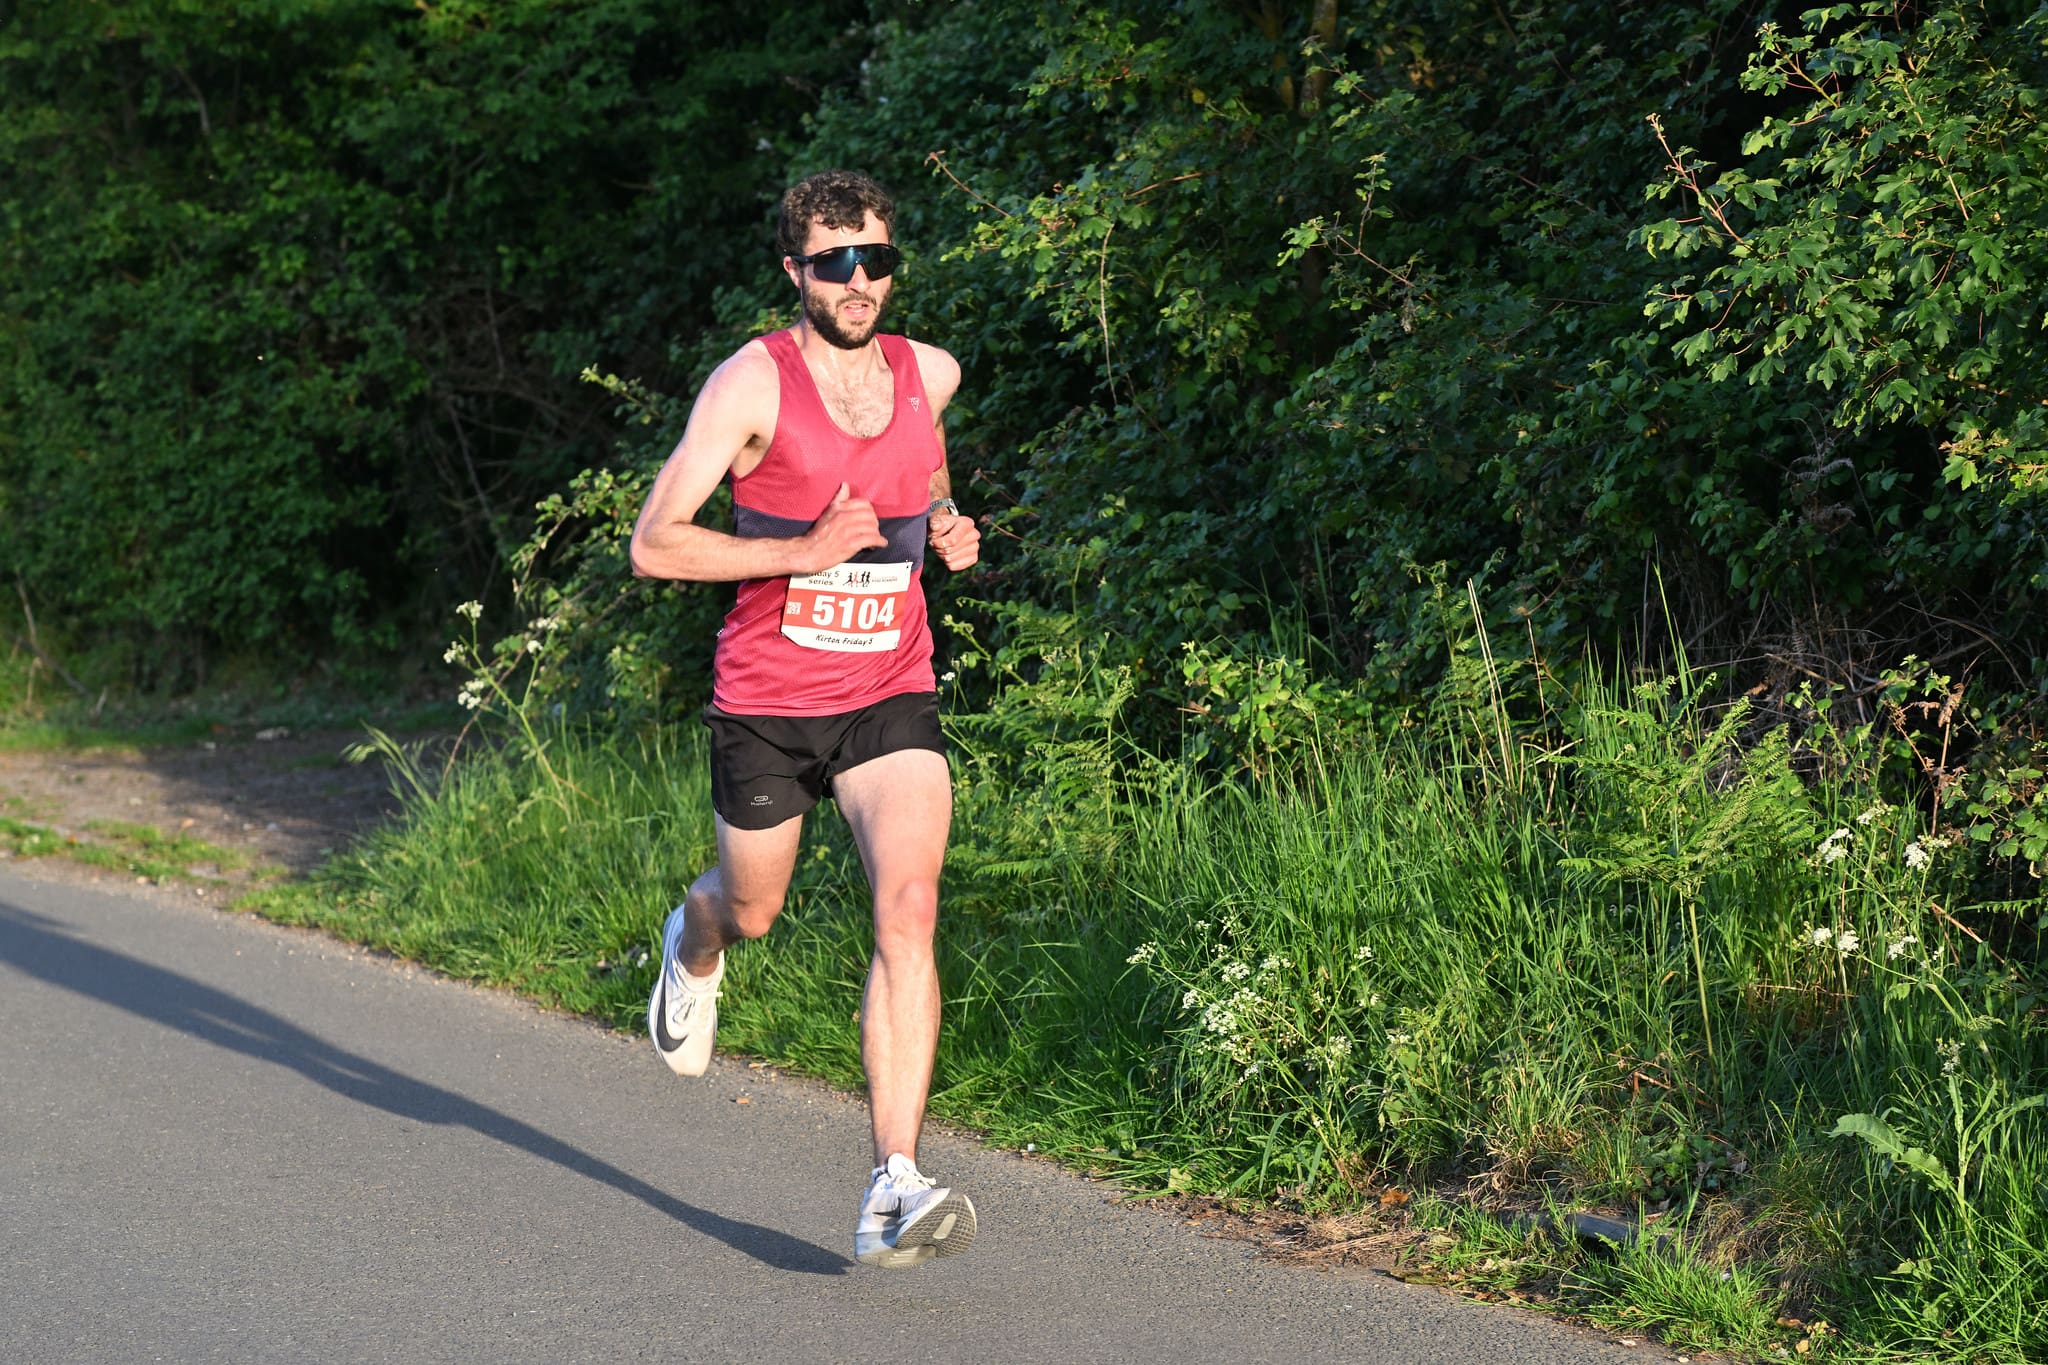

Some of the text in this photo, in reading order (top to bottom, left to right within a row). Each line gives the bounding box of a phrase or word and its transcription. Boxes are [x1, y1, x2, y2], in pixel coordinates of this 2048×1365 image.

[834, 570, 840, 578] 5
[812, 594, 896, 630] 5104
[815, 634, 874, 646] Kirton Friday 5
